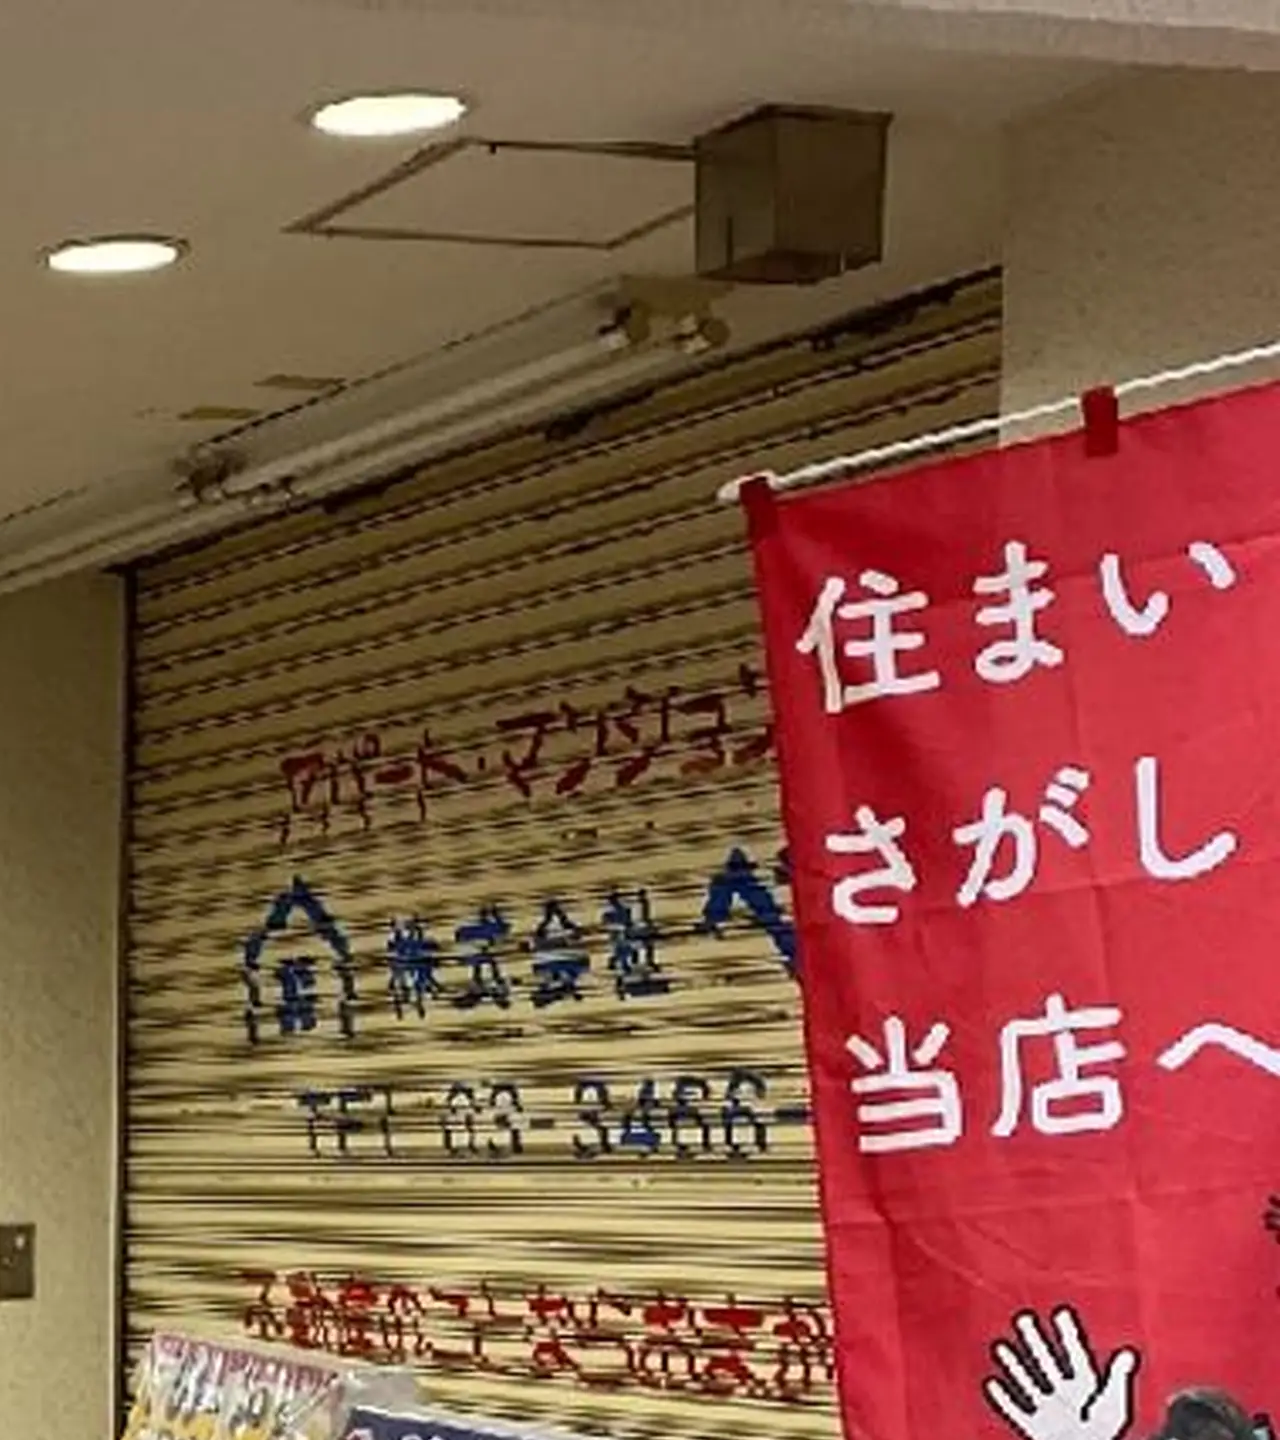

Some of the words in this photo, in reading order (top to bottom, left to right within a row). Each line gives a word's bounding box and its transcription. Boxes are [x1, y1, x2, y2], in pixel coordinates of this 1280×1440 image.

[795, 540, 1238, 714] 住まい
[824, 755, 1238, 925] さがし
[845, 993, 1280, 1153] 当店へ
